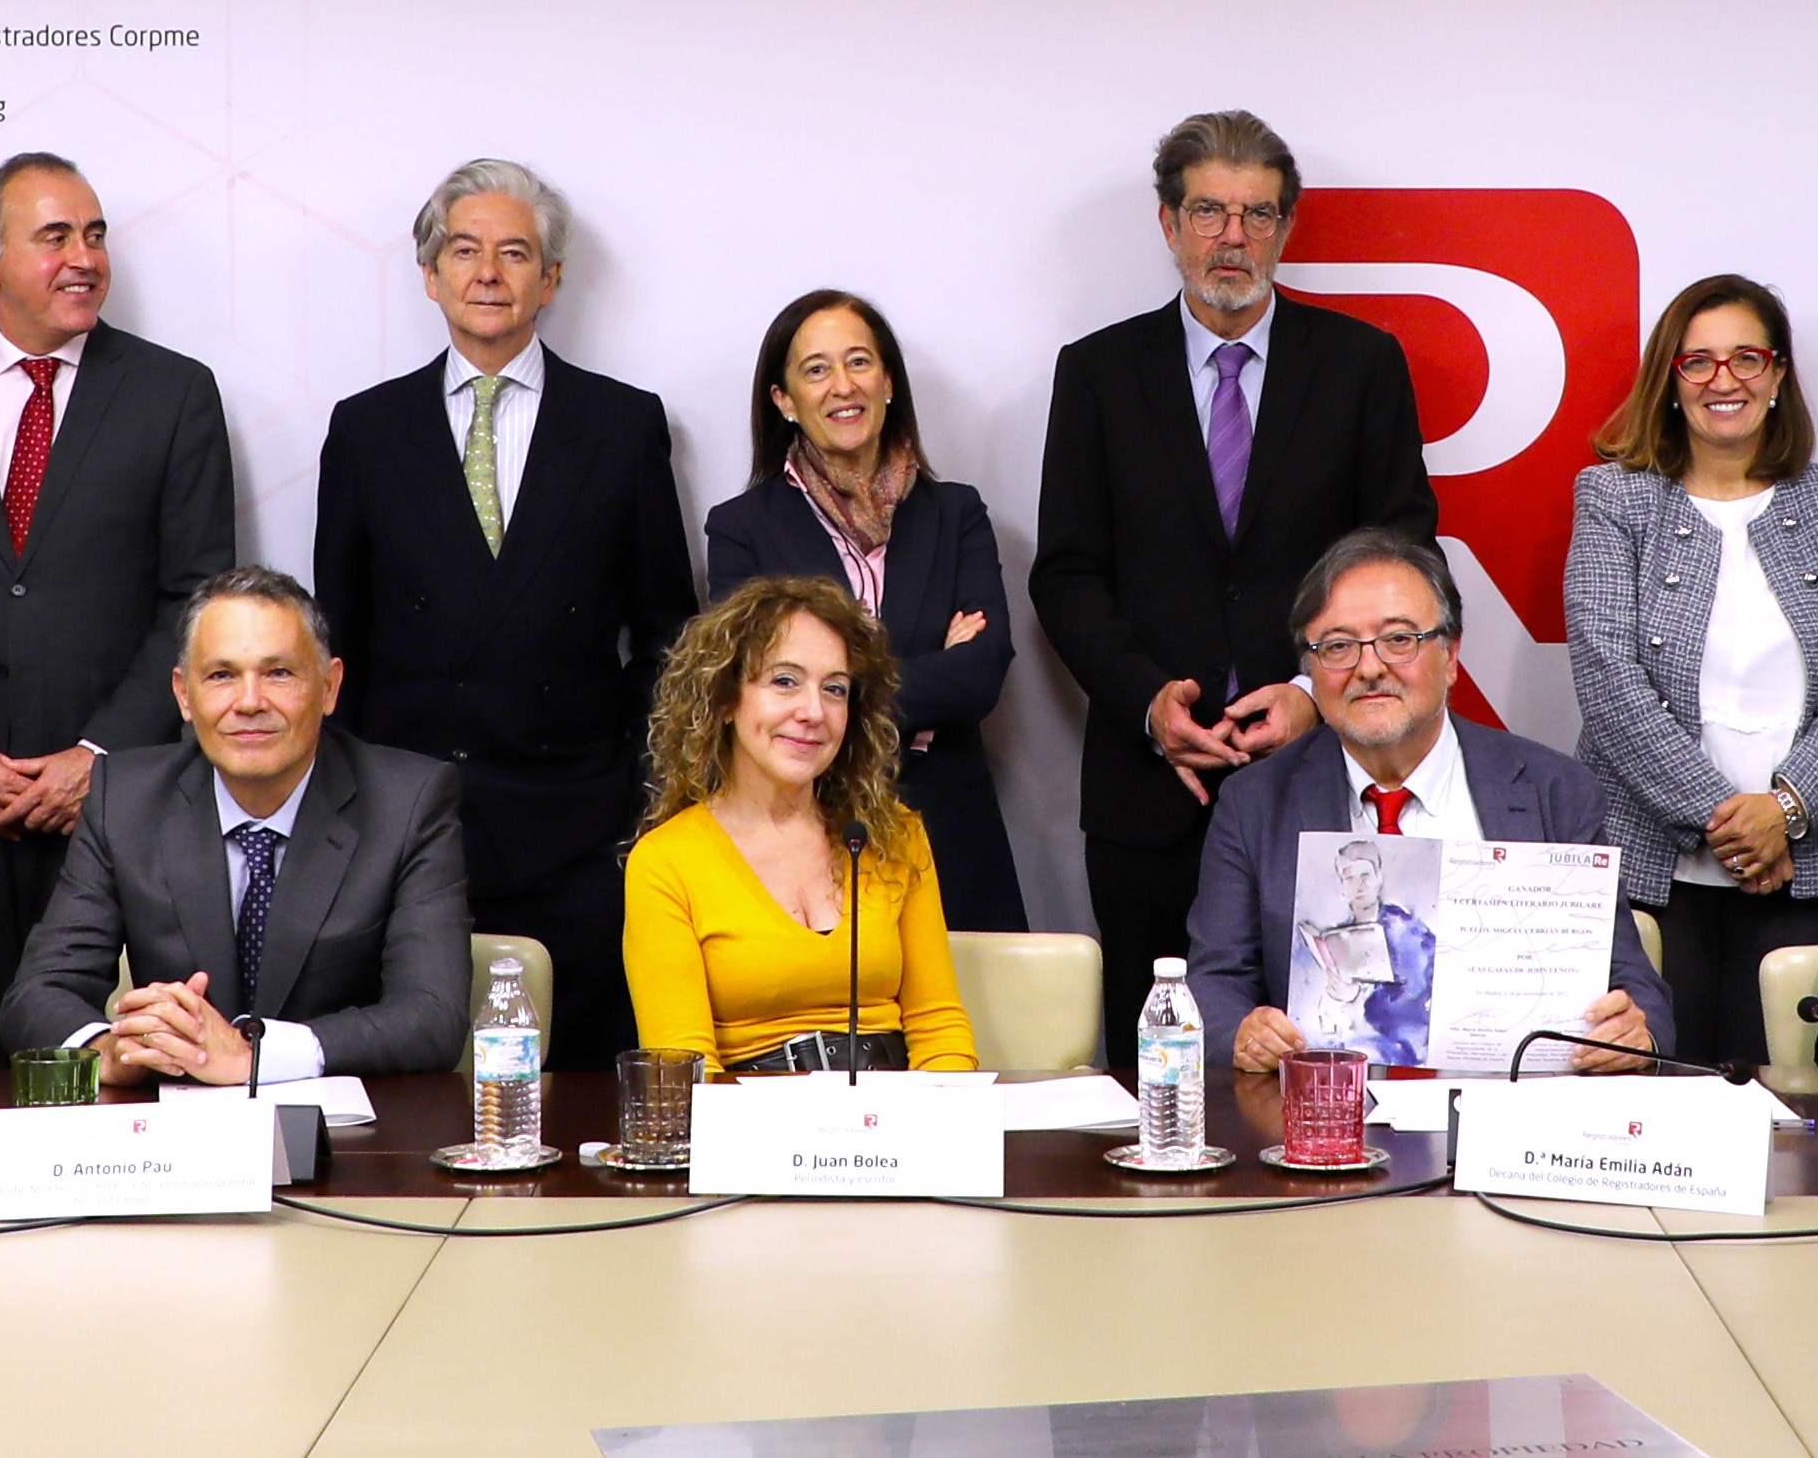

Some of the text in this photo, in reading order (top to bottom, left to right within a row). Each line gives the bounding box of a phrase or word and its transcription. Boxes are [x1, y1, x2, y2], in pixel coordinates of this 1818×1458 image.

[109, 24, 200, 51] Corpme
[74, 1161, 136, 1176] Antonio
[143, 1160, 172, 1173] Pau
[792, 1154, 898, 1170] D. Juan Bolea
[1551, 1153, 1594, 1169] María
[1599, 1157, 1647, 1174] Emilia
[1652, 1161, 1693, 1178] Adán
[1489, 1167, 1727, 1198] Decana del Colegio de Registradores de España
